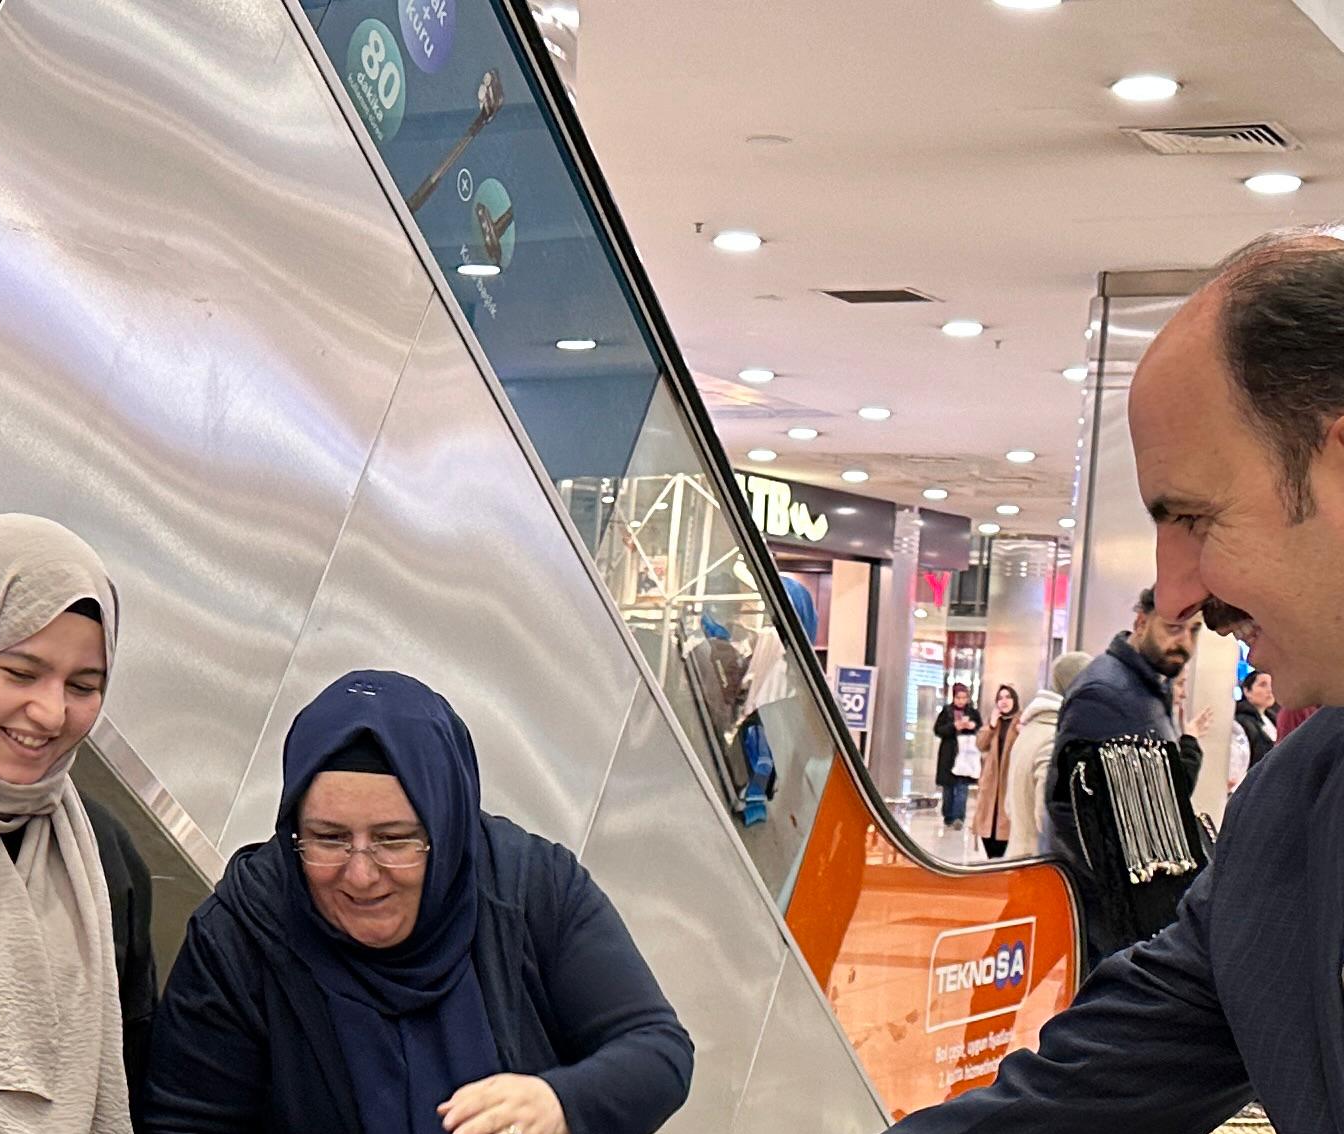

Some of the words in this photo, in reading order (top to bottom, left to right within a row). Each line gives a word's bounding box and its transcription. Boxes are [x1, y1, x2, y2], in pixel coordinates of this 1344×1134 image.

[406, 0, 435, 59] kuru
[361, 29, 401, 110] 80
[357, 72, 384, 122] dakika
[935, 948, 1024, 994] TEKNOSA
